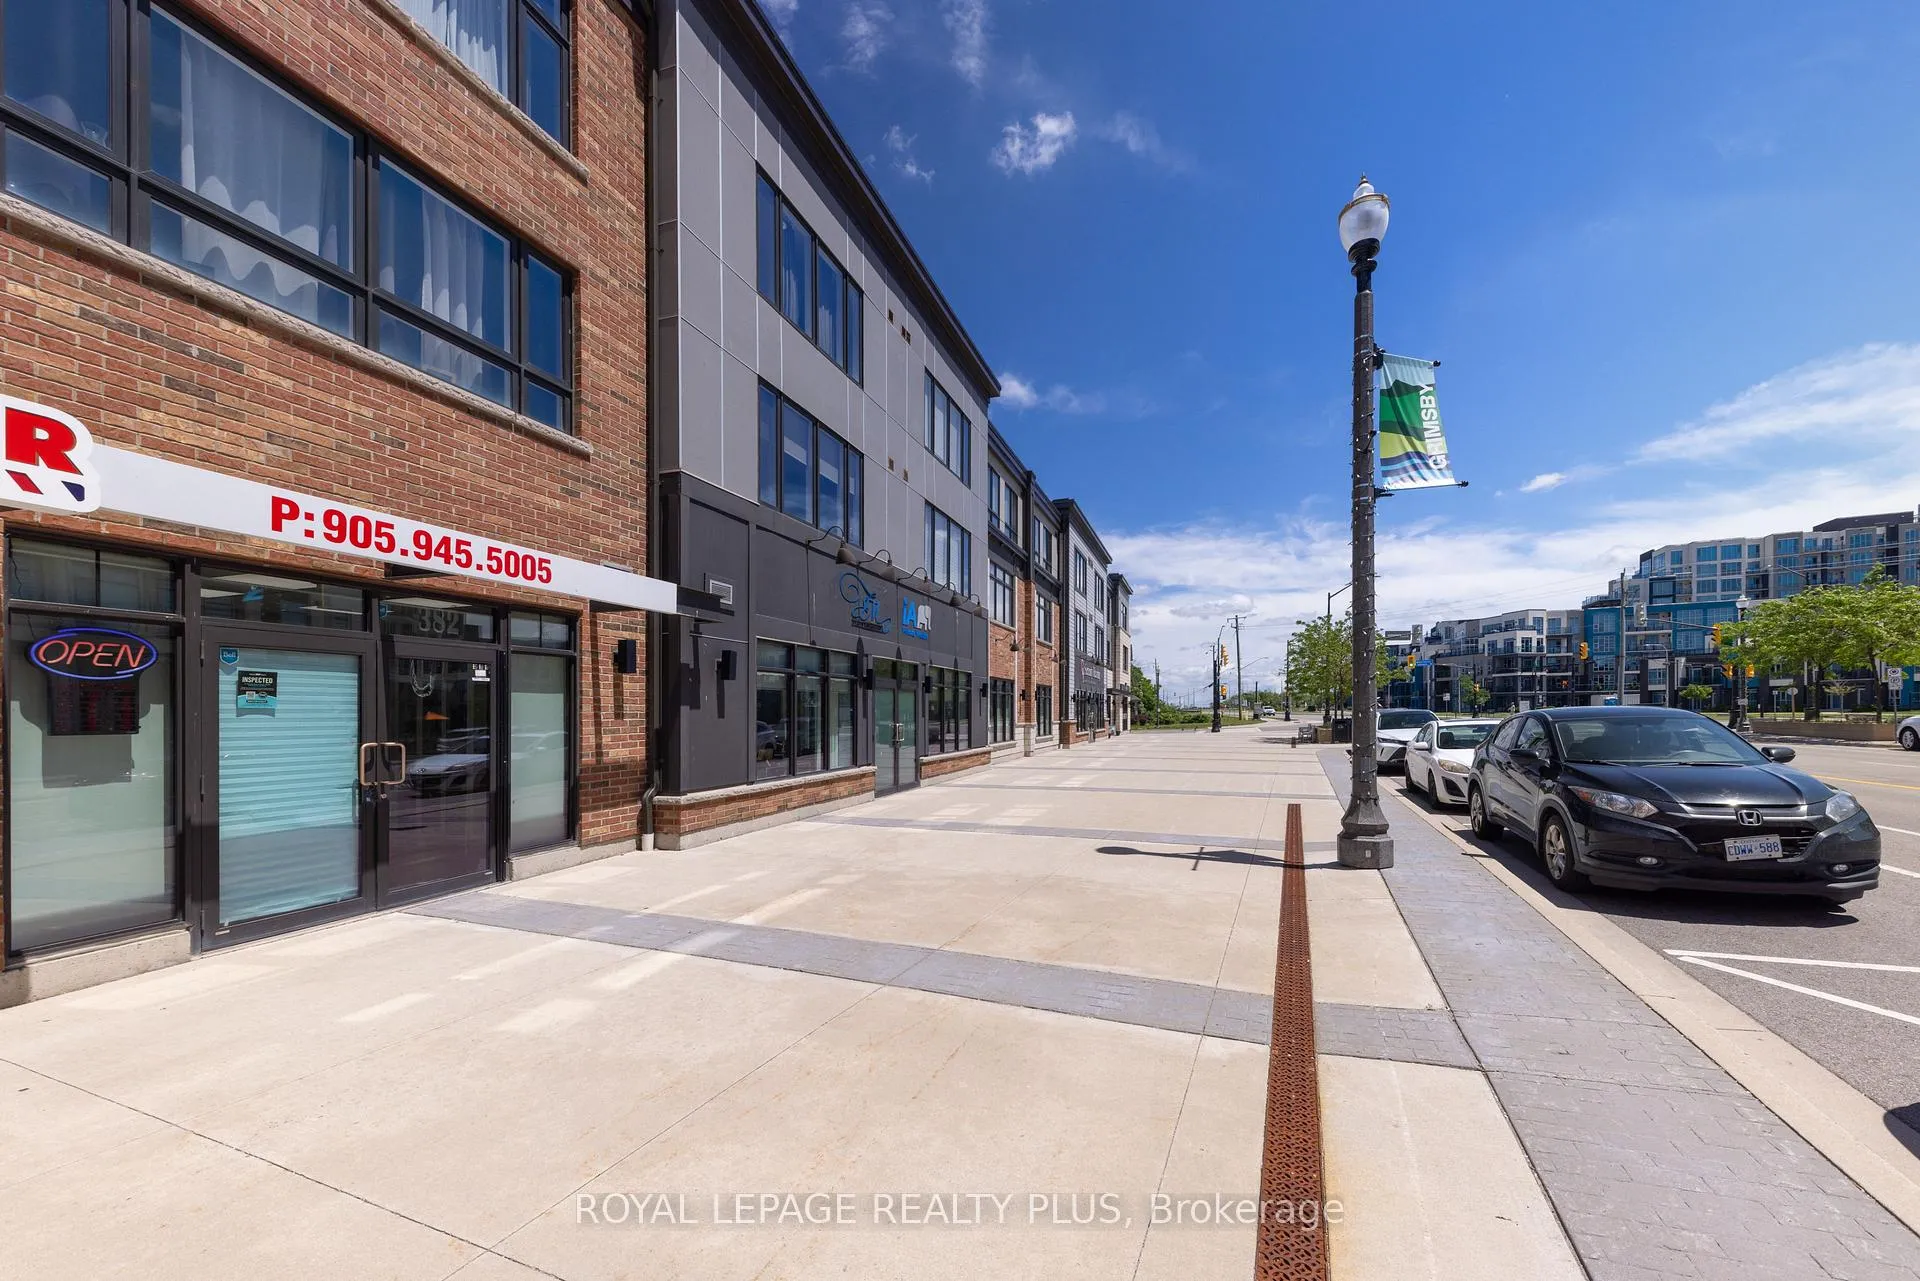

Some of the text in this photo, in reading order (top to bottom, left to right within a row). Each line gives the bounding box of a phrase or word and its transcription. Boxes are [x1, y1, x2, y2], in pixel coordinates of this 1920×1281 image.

[419, 607, 460, 635] 382
[39, 640, 146, 668] OPEN
[241, 676, 274, 684] INSPECTED
[1759, 841, 1780, 853] 588
